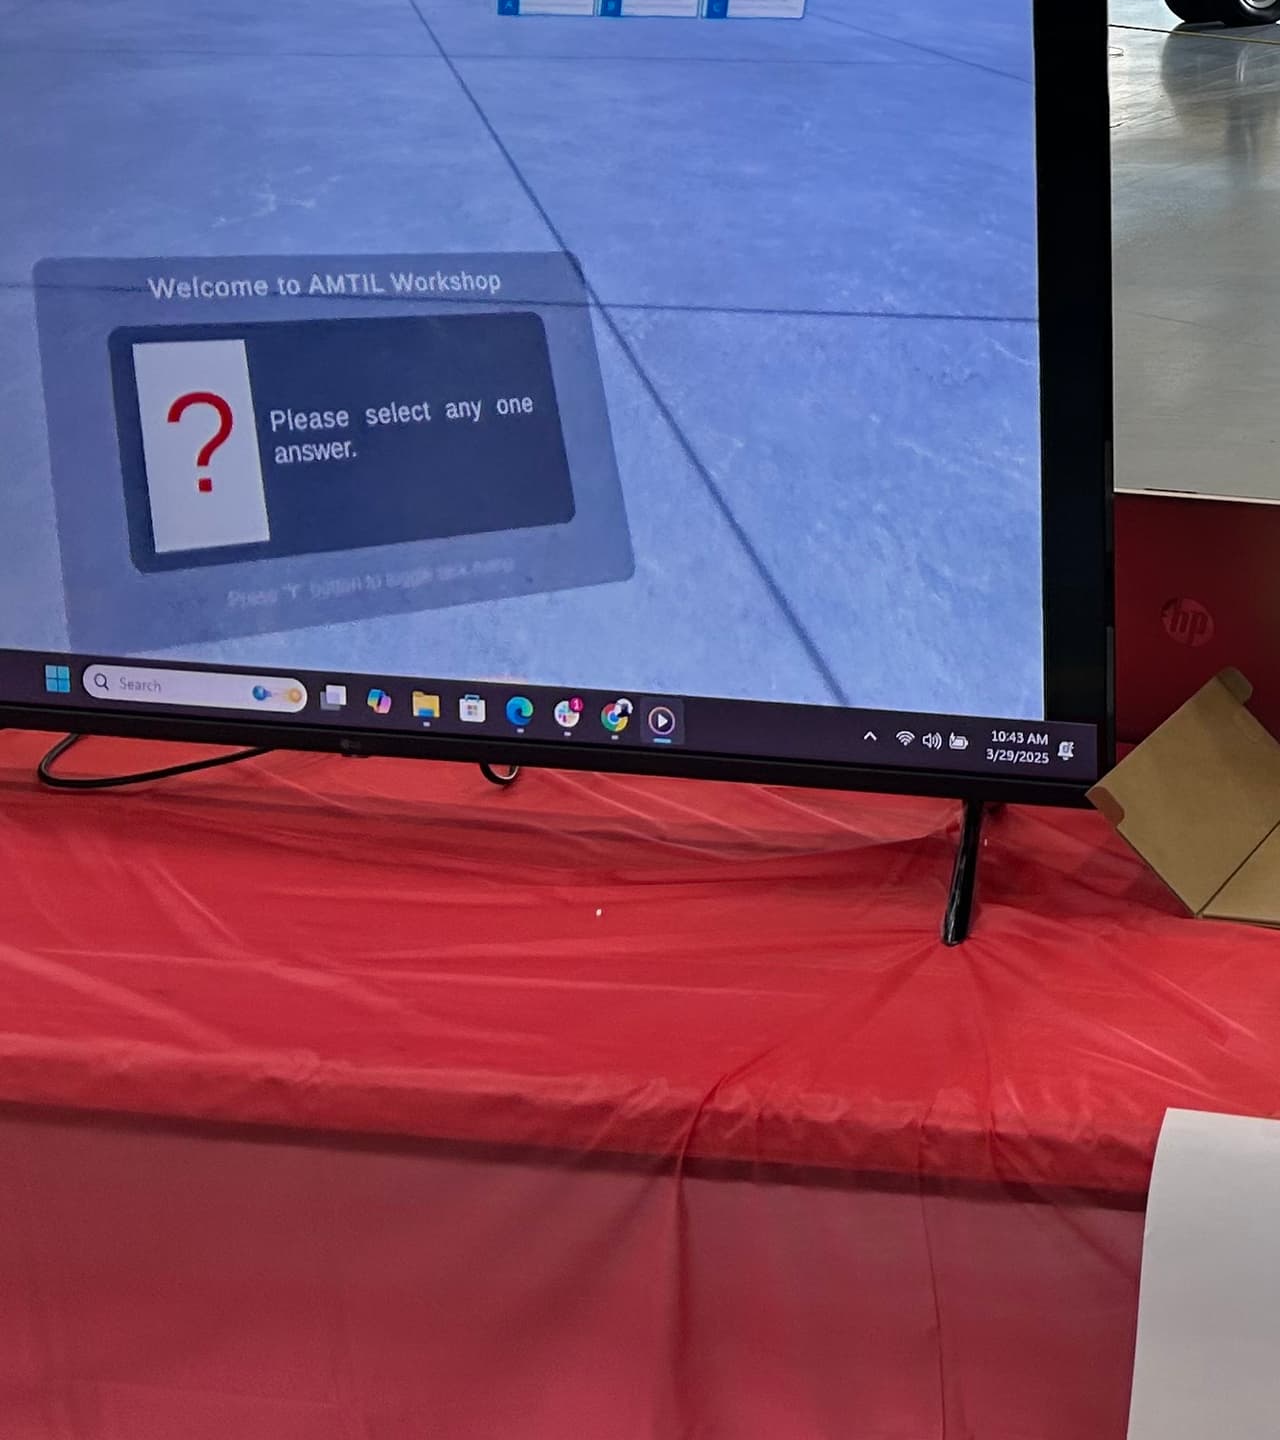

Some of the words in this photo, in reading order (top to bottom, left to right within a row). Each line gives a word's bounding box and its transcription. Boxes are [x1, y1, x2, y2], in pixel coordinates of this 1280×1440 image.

[148, 277, 268, 299] Welcome
[277, 278, 301, 296] to
[308, 273, 386, 295] AMTIL
[390, 271, 502, 294] Workshop
[270, 407, 350, 432] Please
[366, 401, 432, 425] select
[445, 397, 483, 423] any
[496, 394, 534, 417] one
[167, 391, 234, 493] ?
[275, 439, 357, 464] answer.
[119, 676, 162, 693] Search
[991, 730, 1024, 744] 10:43
[1027, 732, 1049, 746] AM
[986, 748, 1050, 764] 3/29/2025
